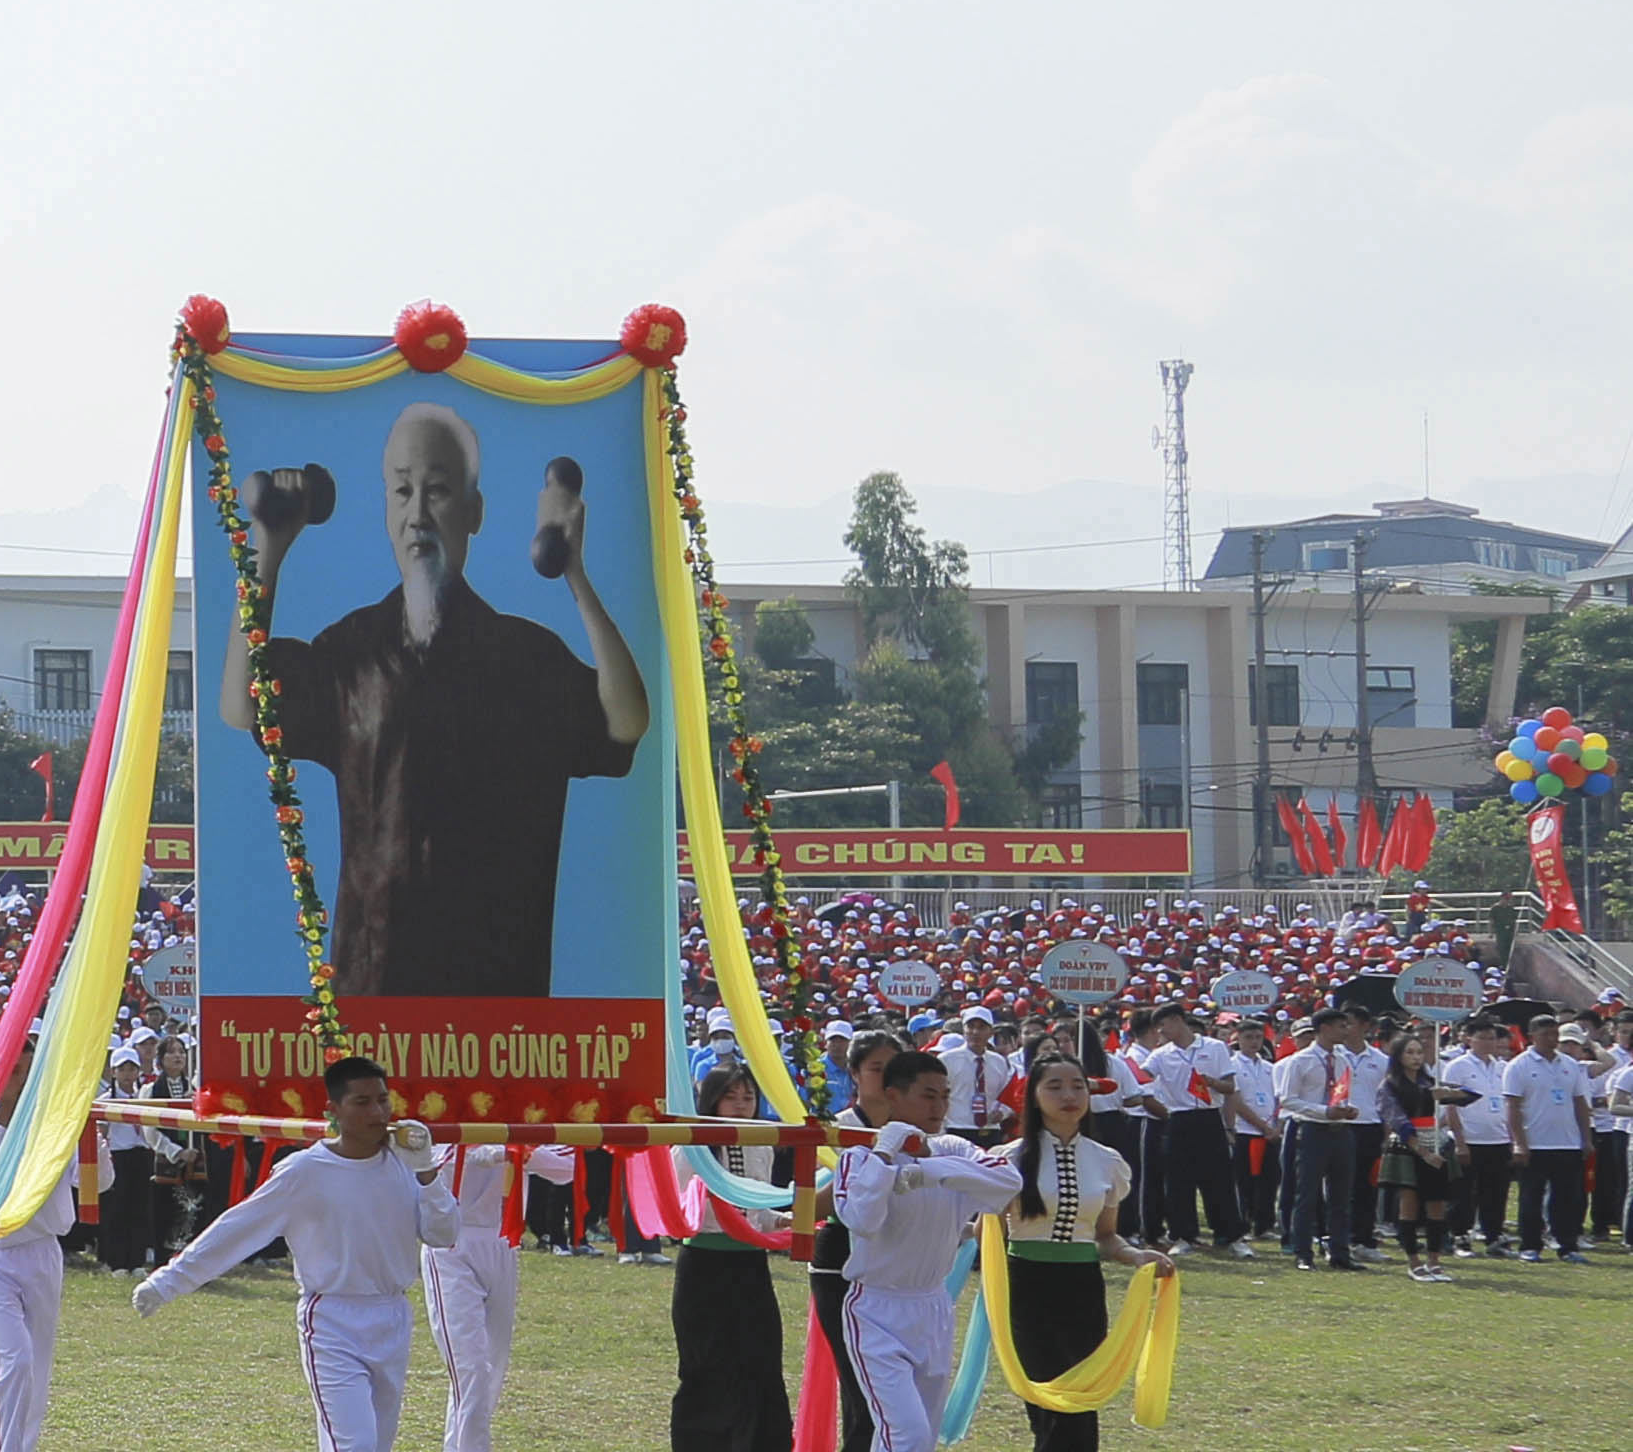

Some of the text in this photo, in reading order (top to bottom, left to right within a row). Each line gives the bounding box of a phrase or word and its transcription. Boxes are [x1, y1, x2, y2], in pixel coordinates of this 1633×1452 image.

[796, 837, 1086, 865] CHÚNG TA!
[220, 1019, 646, 1089] “TỰ TÔI GÀY NÀO CŨNG TẬP”
